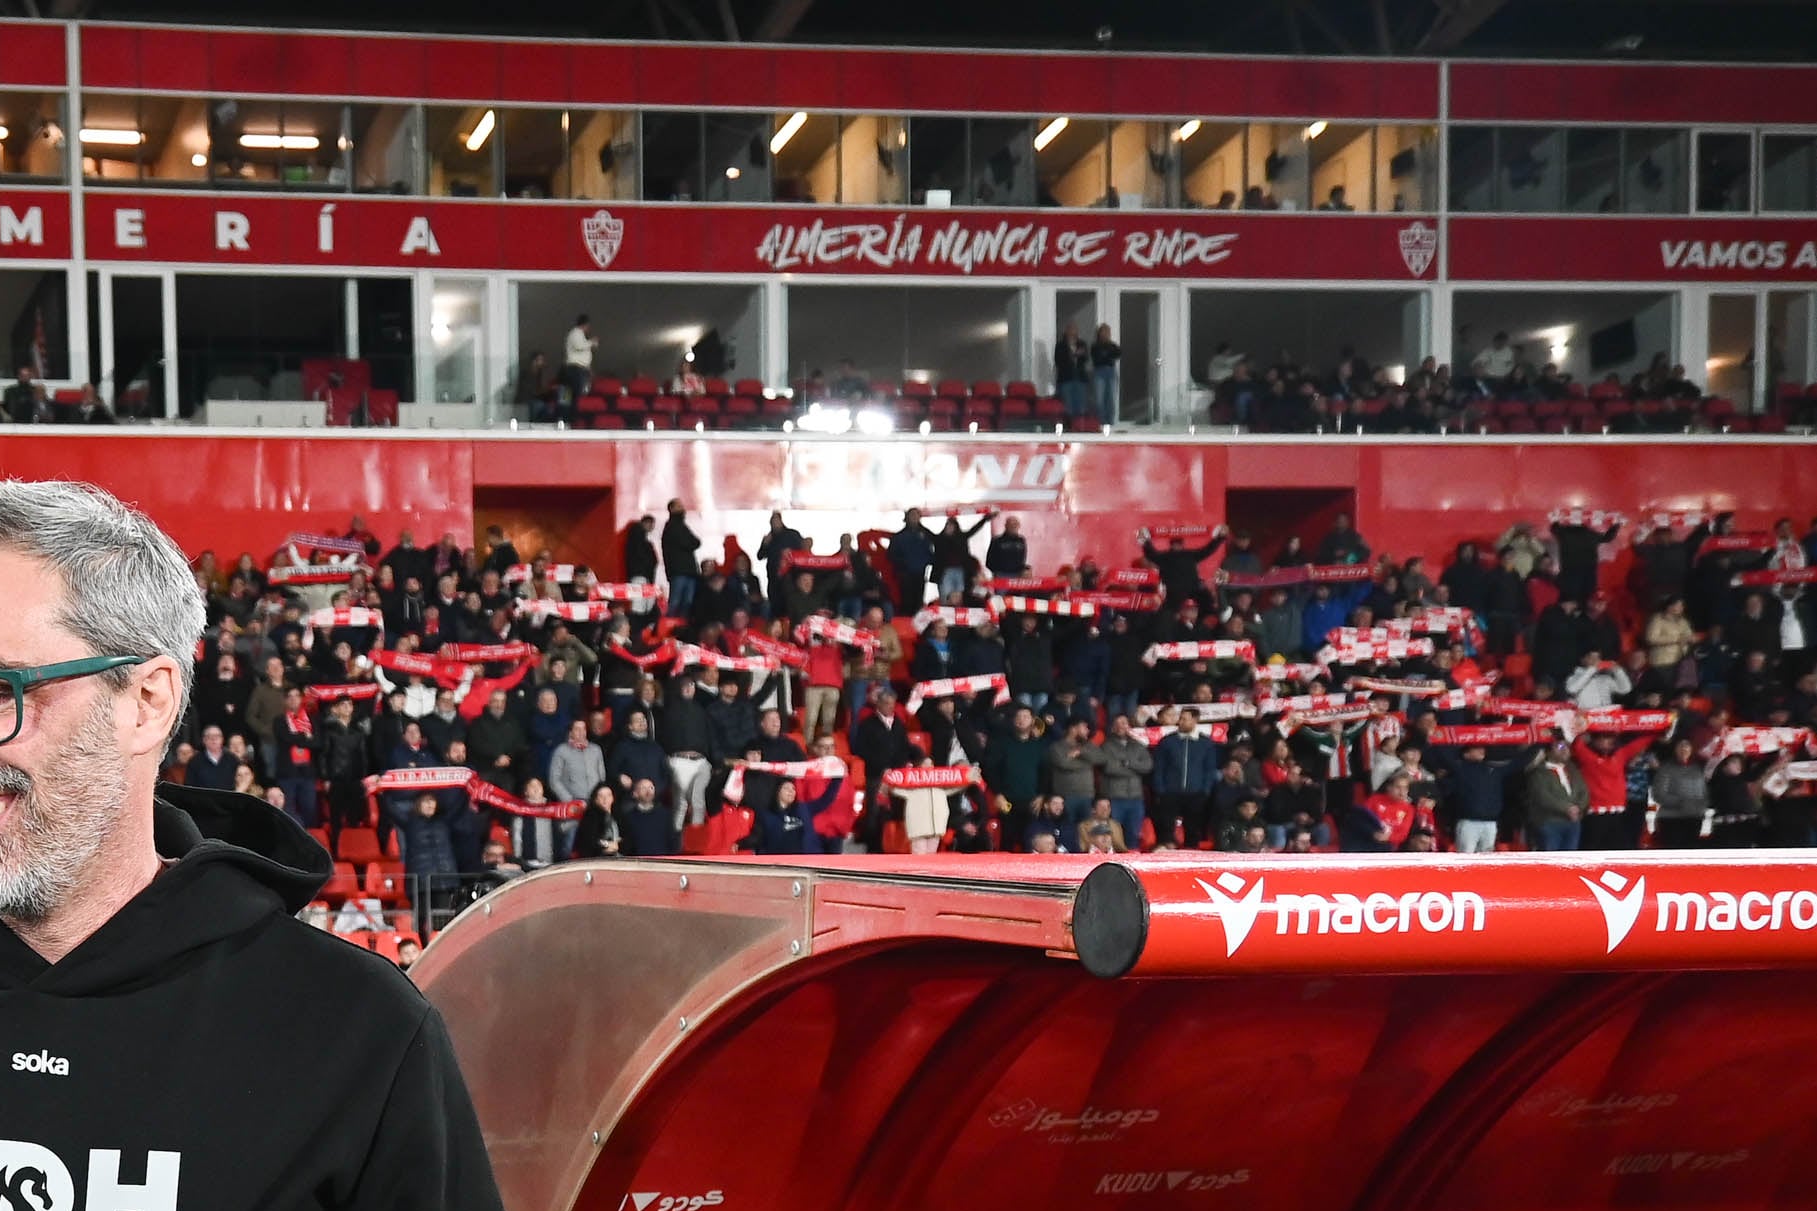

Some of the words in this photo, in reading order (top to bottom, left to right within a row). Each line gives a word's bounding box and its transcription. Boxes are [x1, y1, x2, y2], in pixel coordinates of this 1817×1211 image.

[756, 213, 923, 268] ALMERÍA
[928, 220, 1048, 274] NUNCA
[1053, 230, 1115, 265] SE
[1122, 228, 1240, 269] RINDE
[1660, 240, 1788, 268] VAMOS
[907, 769, 962, 784] ALMERIA
[1275, 891, 1485, 935] macron
[12, 1050, 69, 1076] soka
[1096, 1172, 1164, 1195] KUDU
